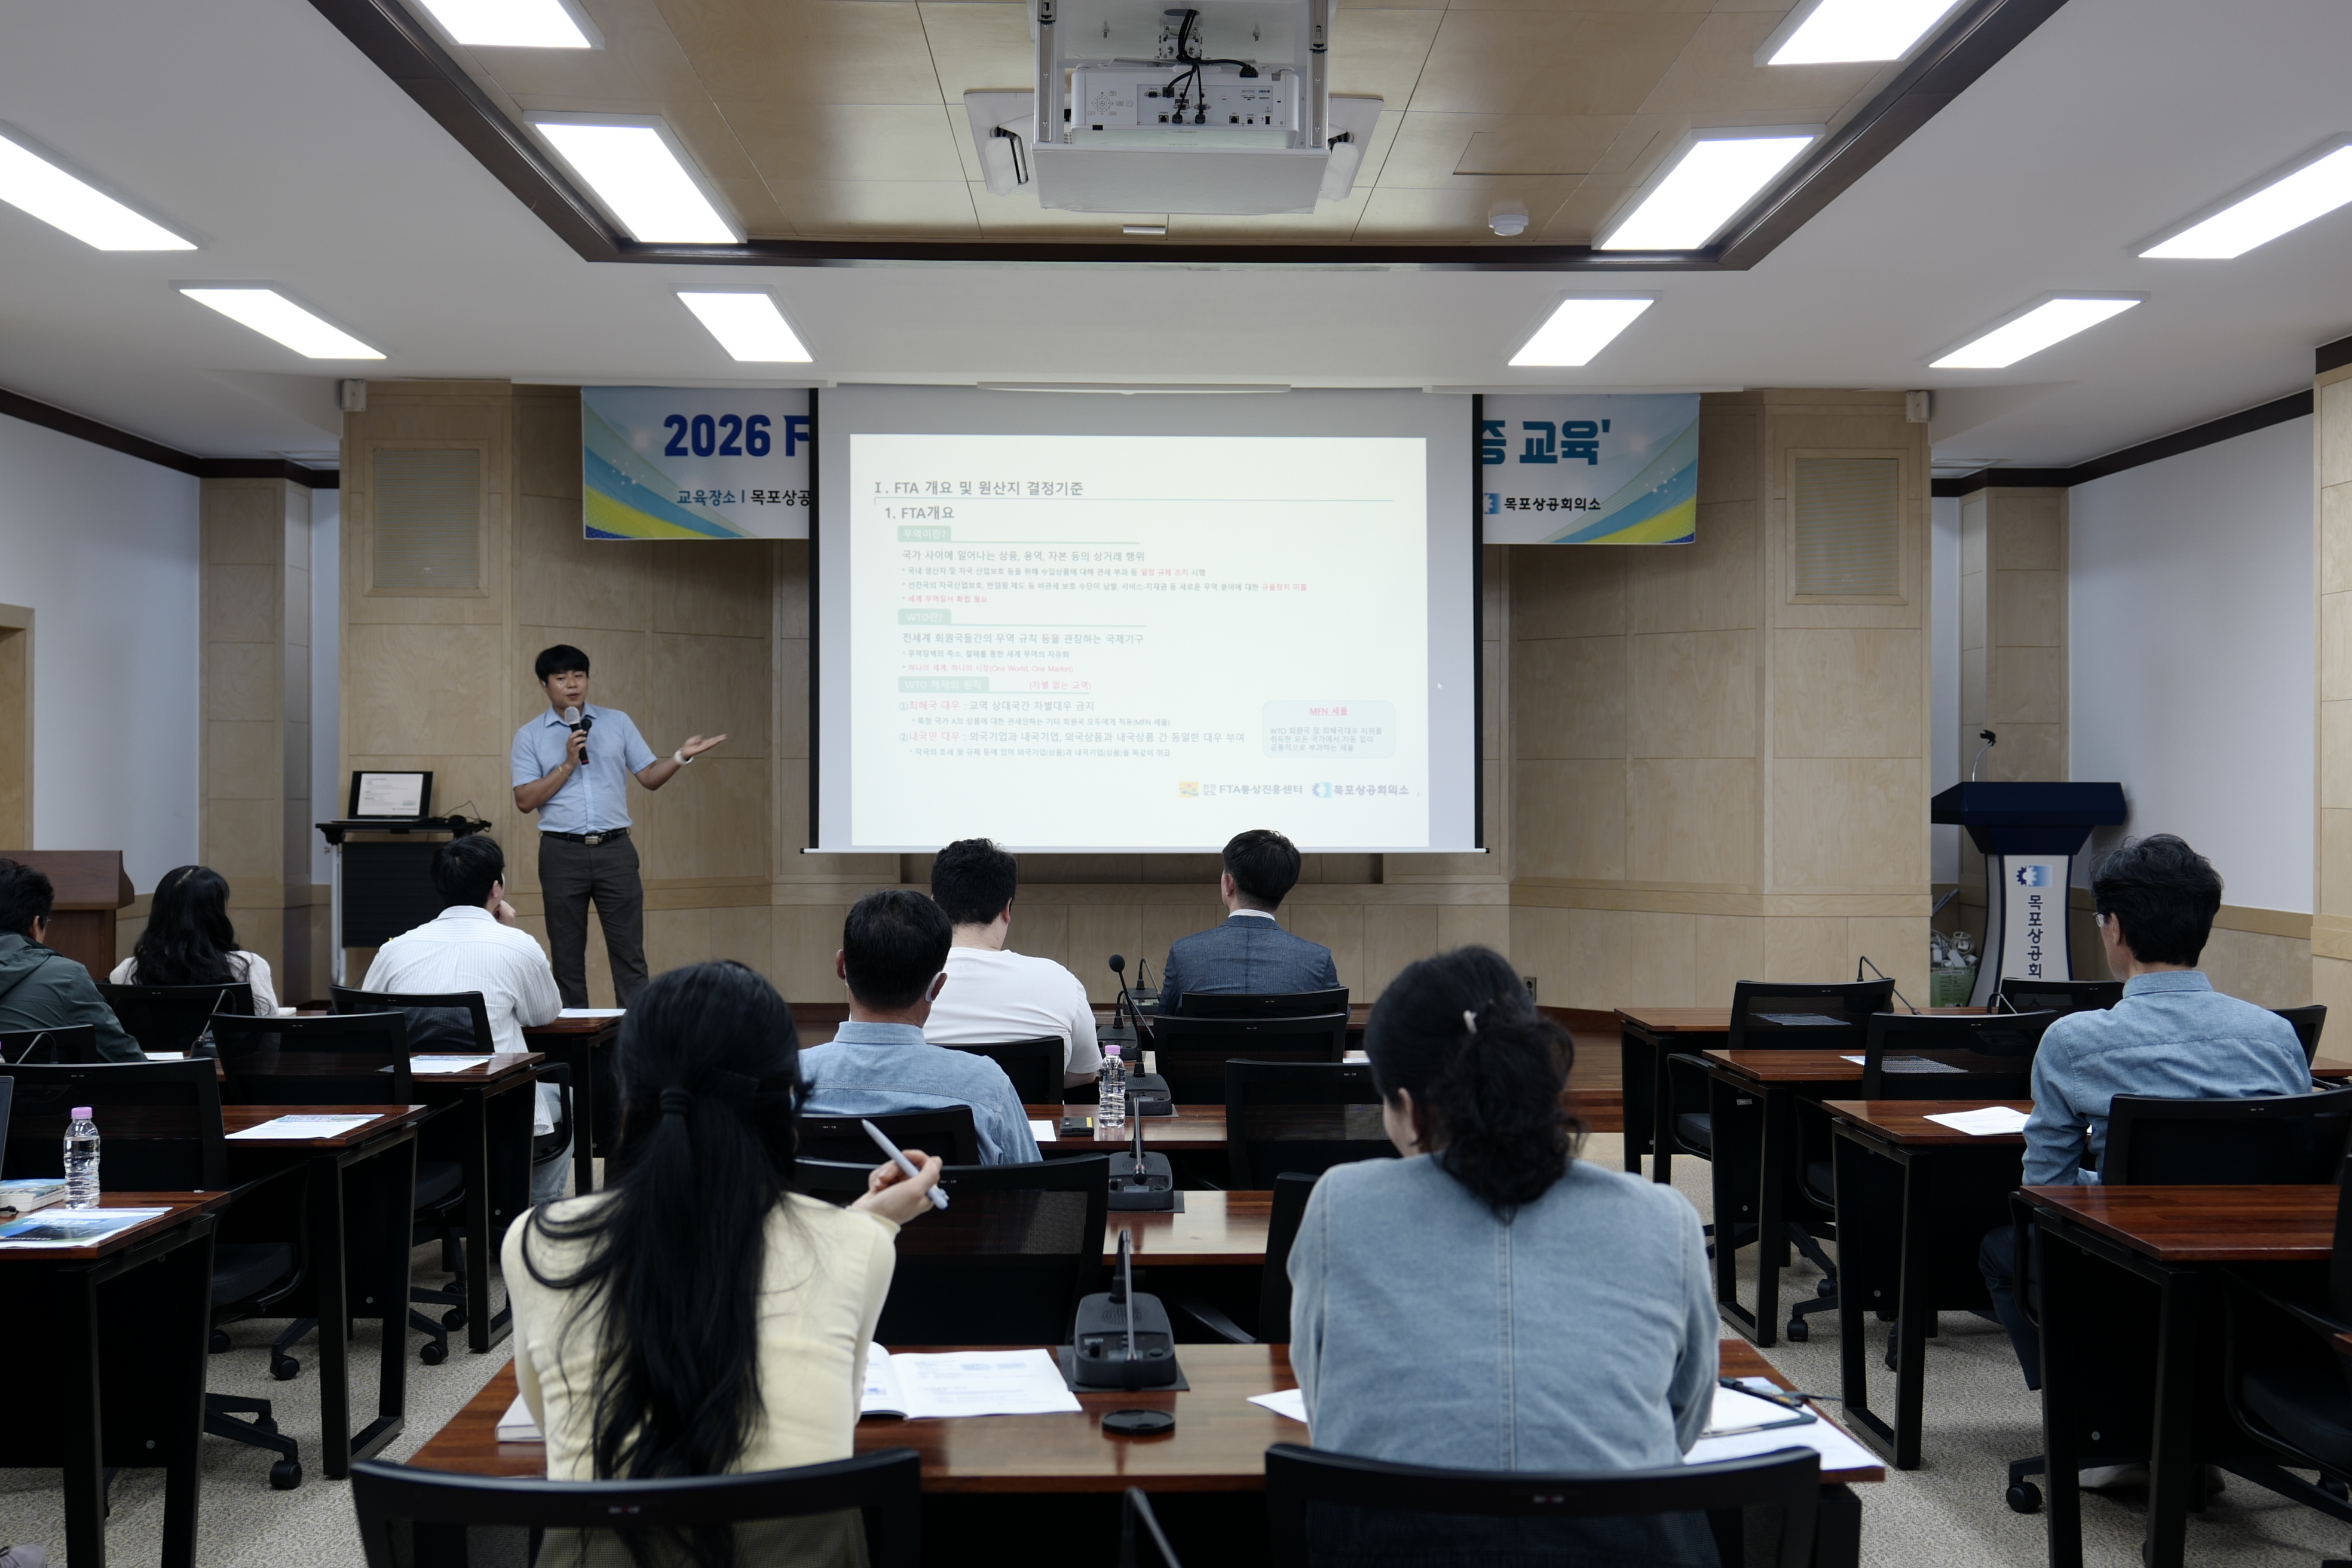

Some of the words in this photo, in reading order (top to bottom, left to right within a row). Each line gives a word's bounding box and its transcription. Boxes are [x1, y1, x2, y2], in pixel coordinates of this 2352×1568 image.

[664, 414, 771, 457] 2026
[895, 482, 919, 494] FTA
[926, 480, 953, 495] 개요
[960, 481, 972, 495] 및
[979, 480, 1019, 496] 원산지
[1027, 482, 1083, 496] 결정기준
[677, 490, 736, 506] 교육장소
[1504, 497, 1601, 511] 목포상공회의소
[886, 507, 896, 519] 1.
[902, 506, 954, 520] FTA개요
[904, 529, 946, 539] 무역이란?
[902, 550, 921, 560] 국가
[925, 550, 953, 561] 사이에
[958, 550, 995, 561] 일어나는
[999, 551, 1019, 561] 상품,
[1024, 551, 1045, 562] 용역,
[1049, 551, 1067, 561] 자본
[1071, 551, 1089, 562] 등의
[1094, 552, 1122, 562] 상거래
[1126, 552, 1144, 562] 행위
[906, 612, 943, 621] WTO란?
[903, 633, 930, 643] 전세계
[935, 633, 991, 644] 회원국들간의
[996, 633, 1014, 644] 무역
[1018, 633, 1037, 644] 규칙
[1041, 633, 1059, 644] 등을
[1064, 634, 1101, 644] 관장하는
[1105, 635, 1143, 645] 국제기구
[932, 680, 959, 690] 체제의
[963, 680, 981, 690] 원칙
[1030, 681, 1048, 690] (차별
[1053, 681, 1068, 690] 없는
[1072, 681, 1091, 690] 교역)
[941, 700, 960, 710] 대우
[969, 700, 987, 710] 교역
[992, 700, 1030, 710] 상대국간
[1034, 700, 1071, 711] 차별대우
[1076, 701, 1094, 711] 금지
[942, 731, 960, 741] 대우
[970, 731, 1018, 742] 외국기업과
[1021, 731, 1061, 743] 내국기업,
[1065, 732, 1113, 742] 외국상품과
[1117, 733, 1154, 742] 내국상품
[1159, 733, 1168, 742] 간
[1171, 733, 1199, 742] 동일한
[1204, 733, 1222, 742] 대우
[1226, 732, 1244, 742] 부여
[1334, 785, 1409, 796] 목포상공회의소
